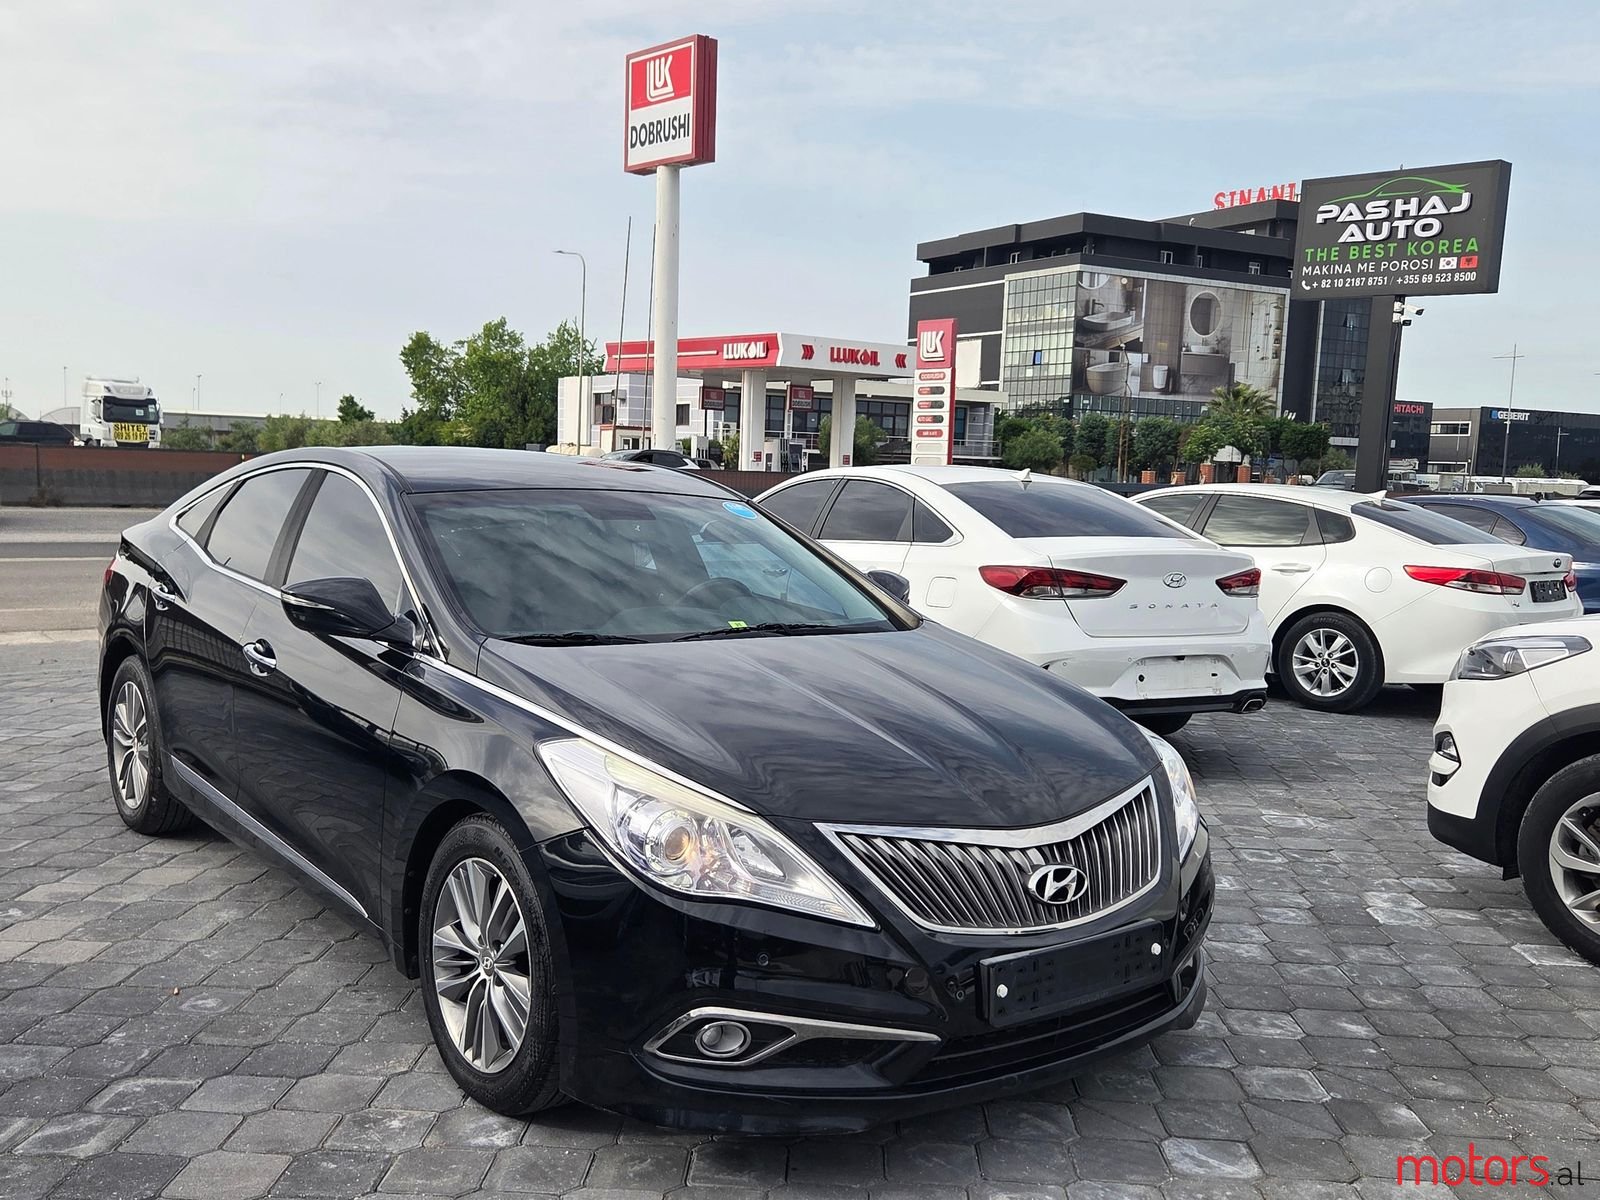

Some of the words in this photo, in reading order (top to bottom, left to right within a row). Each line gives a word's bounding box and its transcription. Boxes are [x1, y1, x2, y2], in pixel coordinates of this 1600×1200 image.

[630, 112, 690, 149] DOBRUSHI
[1316, 192, 1472, 223] PASHAJ
[1337, 217, 1443, 243] AUTO
[1305, 247, 1340, 262] THE
[1349, 243, 1398, 260] BEST
[1407, 238, 1479, 256] KOREA
[1302, 263, 1352, 276] MAKINA
[1357, 262, 1375, 273] ME
[1380, 259, 1434, 272] POROSI
[1321, 278, 1331, 288] 82
[1334, 278, 1344, 288] 10
[1345, 277, 1366, 287] 2187
[1367, 276, 1388, 286] 8751
[1421, 273, 1433, 284] 69
[1435, 272, 1452, 283] 523
[1454, 271, 1477, 282] 8500
[1393, 403, 1425, 414] HITACHI
[1497, 411, 1531, 421] GEBERIT
[113, 423, 148, 432] SHITET
[1128, 602, 1219, 610] SONATA
